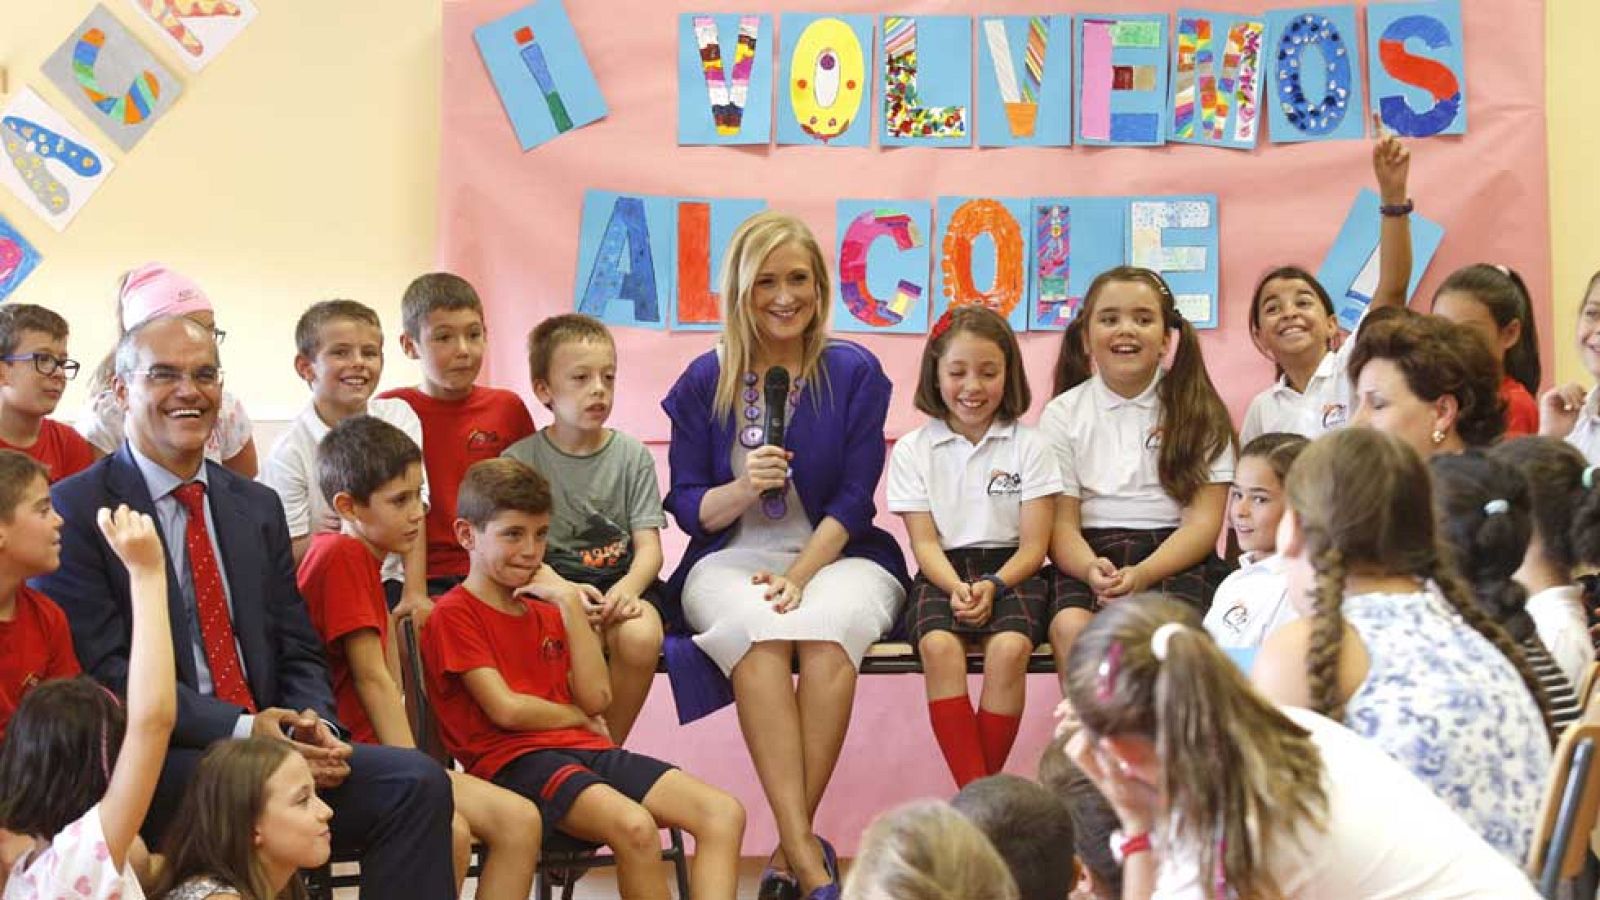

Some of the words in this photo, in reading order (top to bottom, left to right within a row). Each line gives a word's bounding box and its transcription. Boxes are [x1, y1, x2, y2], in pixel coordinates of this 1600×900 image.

[692, 14, 1460, 143] VOLVEMOS
[577, 197, 722, 324] AL
[840, 199, 1210, 327] COLE
